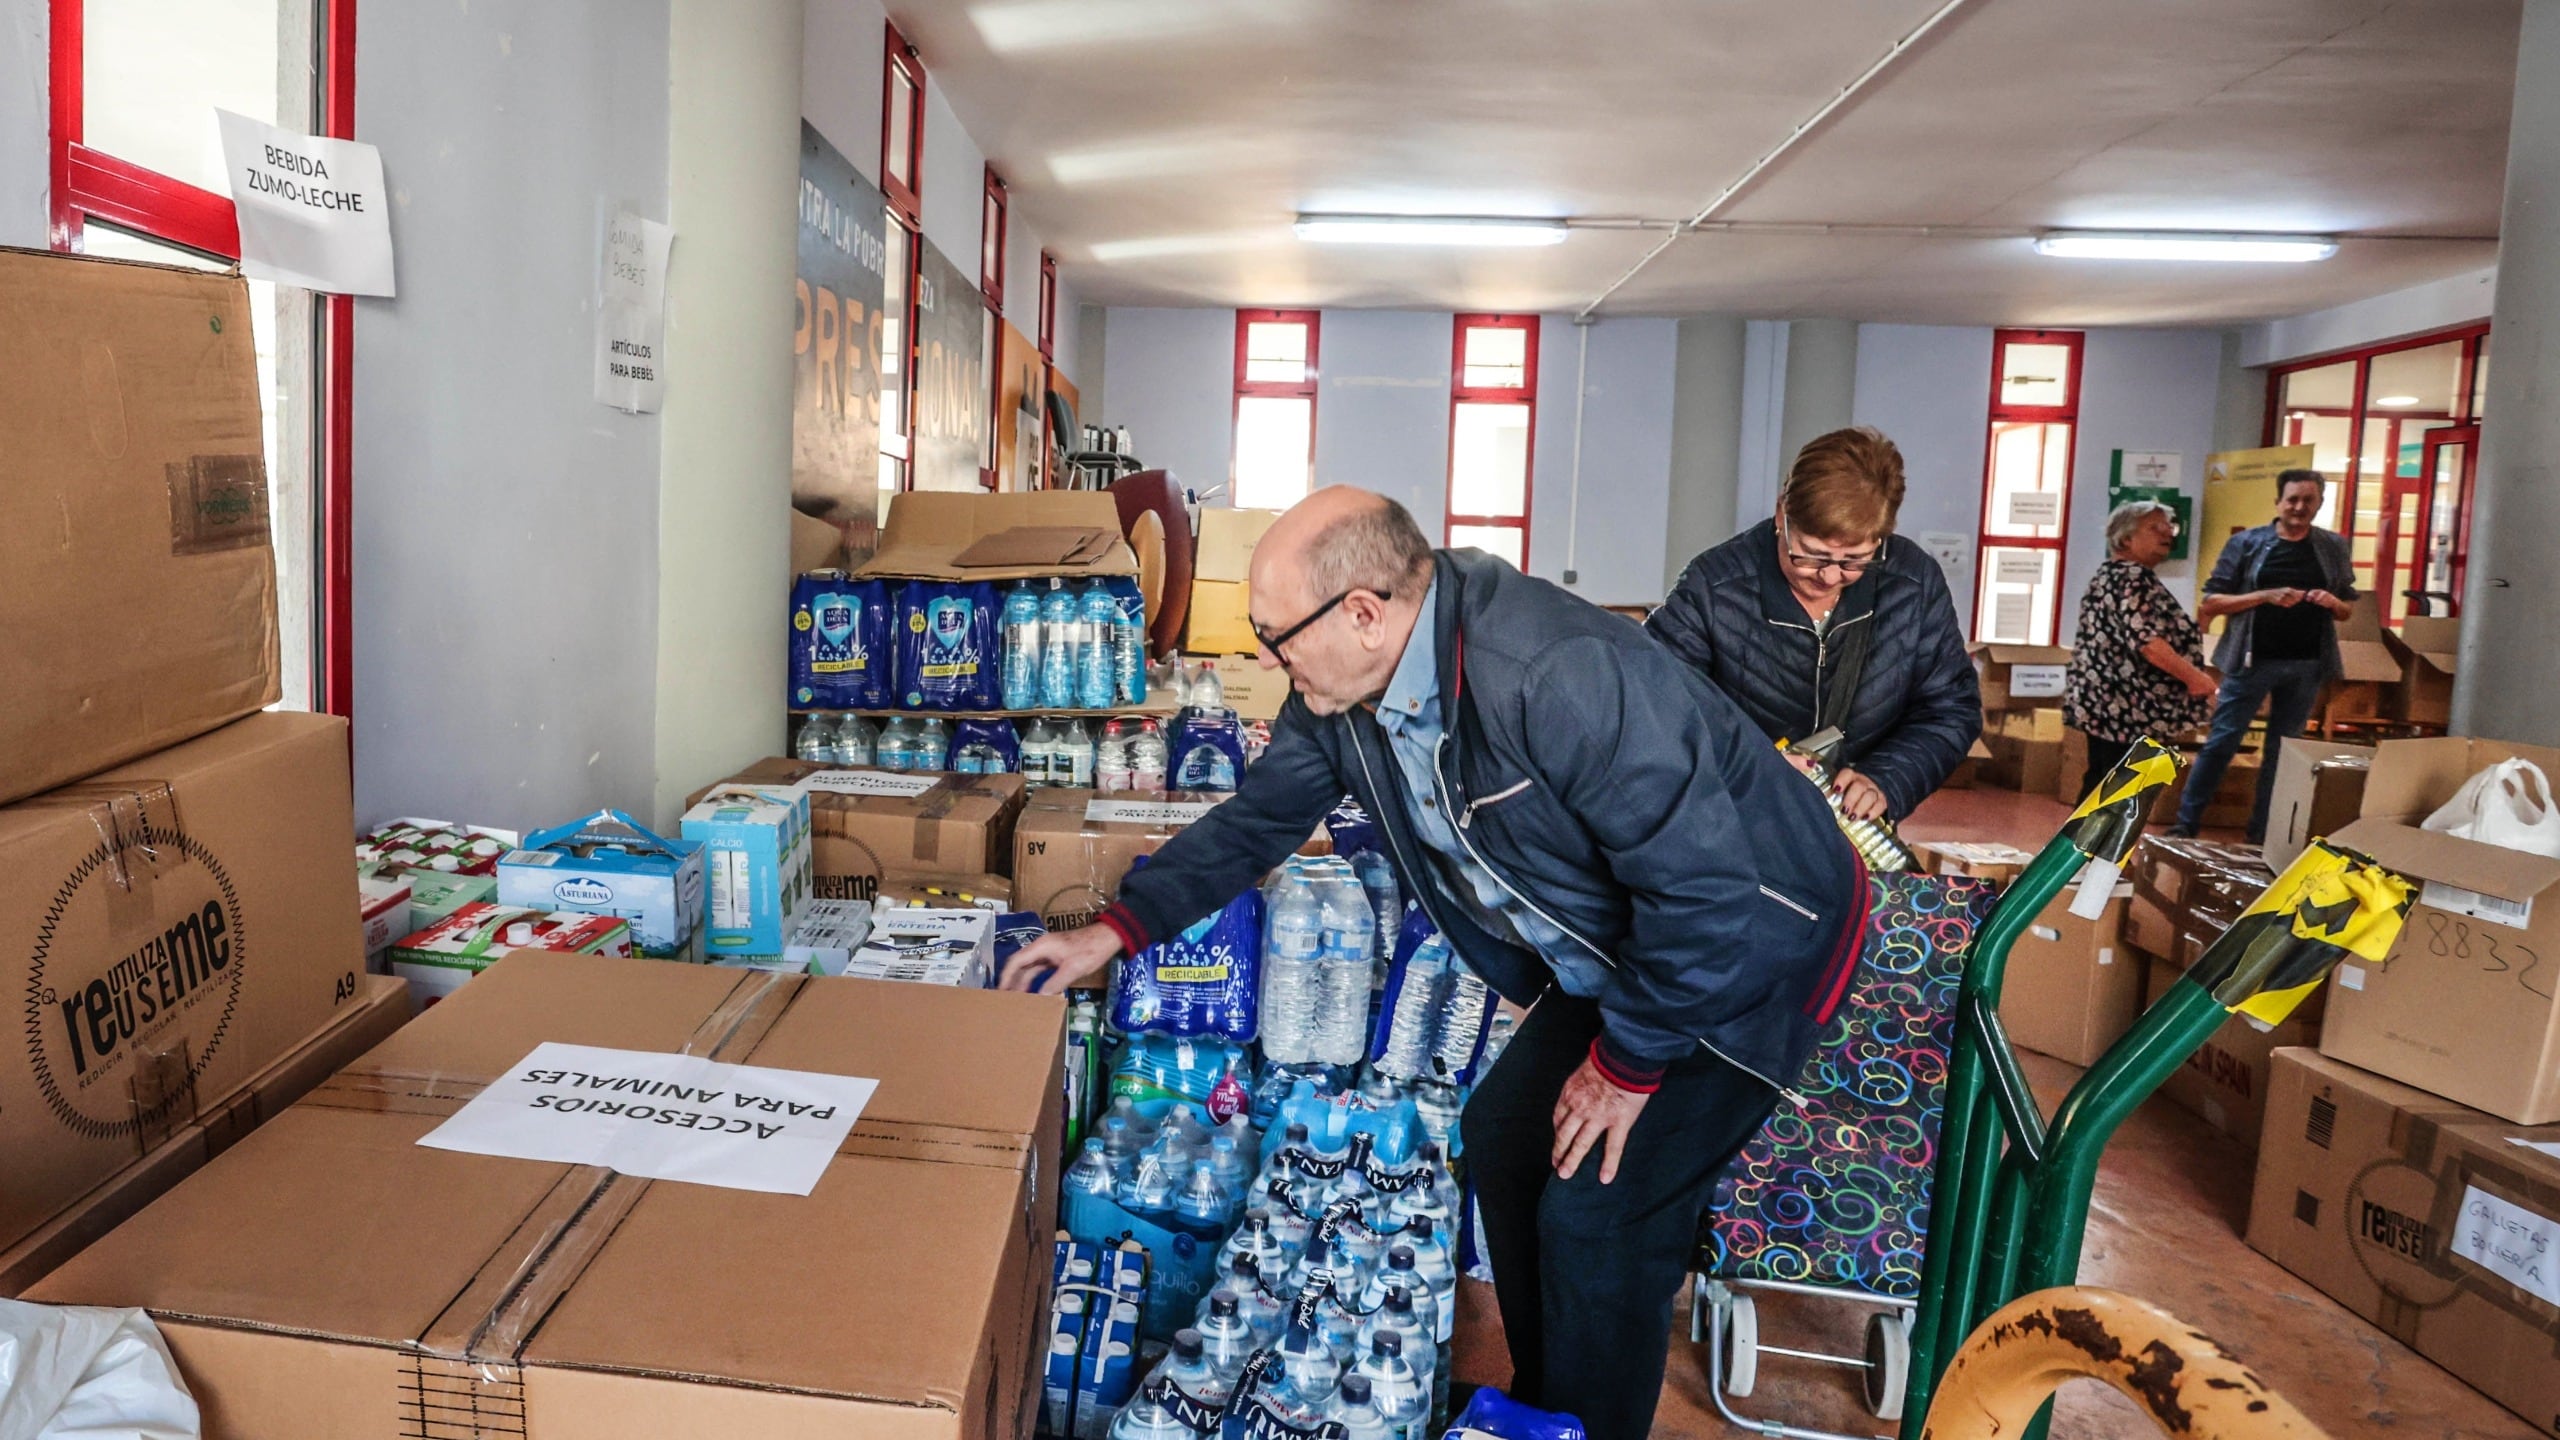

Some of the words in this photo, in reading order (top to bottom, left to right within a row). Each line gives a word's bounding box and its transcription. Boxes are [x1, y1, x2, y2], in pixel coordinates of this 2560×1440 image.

[264, 144, 329, 180] BEBIDA
[247, 168, 364, 212] ZUMO-LECHE
[835, 207, 850, 254] LA
[610, 338, 652, 358] ARTÍCULOS
[610, 362, 630, 378] PARA
[711, 838, 743, 848] CALCIO
[1028, 841, 1046, 856] A8
[557, 884, 609, 901] ASTURIANA
[887, 922, 947, 931] ENTERA
[334, 971, 355, 1006] A9
[1164, 968, 1221, 979] RECICLABLE
[79, 1051, 124, 1091] REDUCIR
[521, 1069, 725, 1103] ANIMALES
[529, 1094, 786, 1140] ACCESORIOS
[735, 1093, 837, 1120] PARA
[2468, 1201, 2550, 1253] GALLETAS
